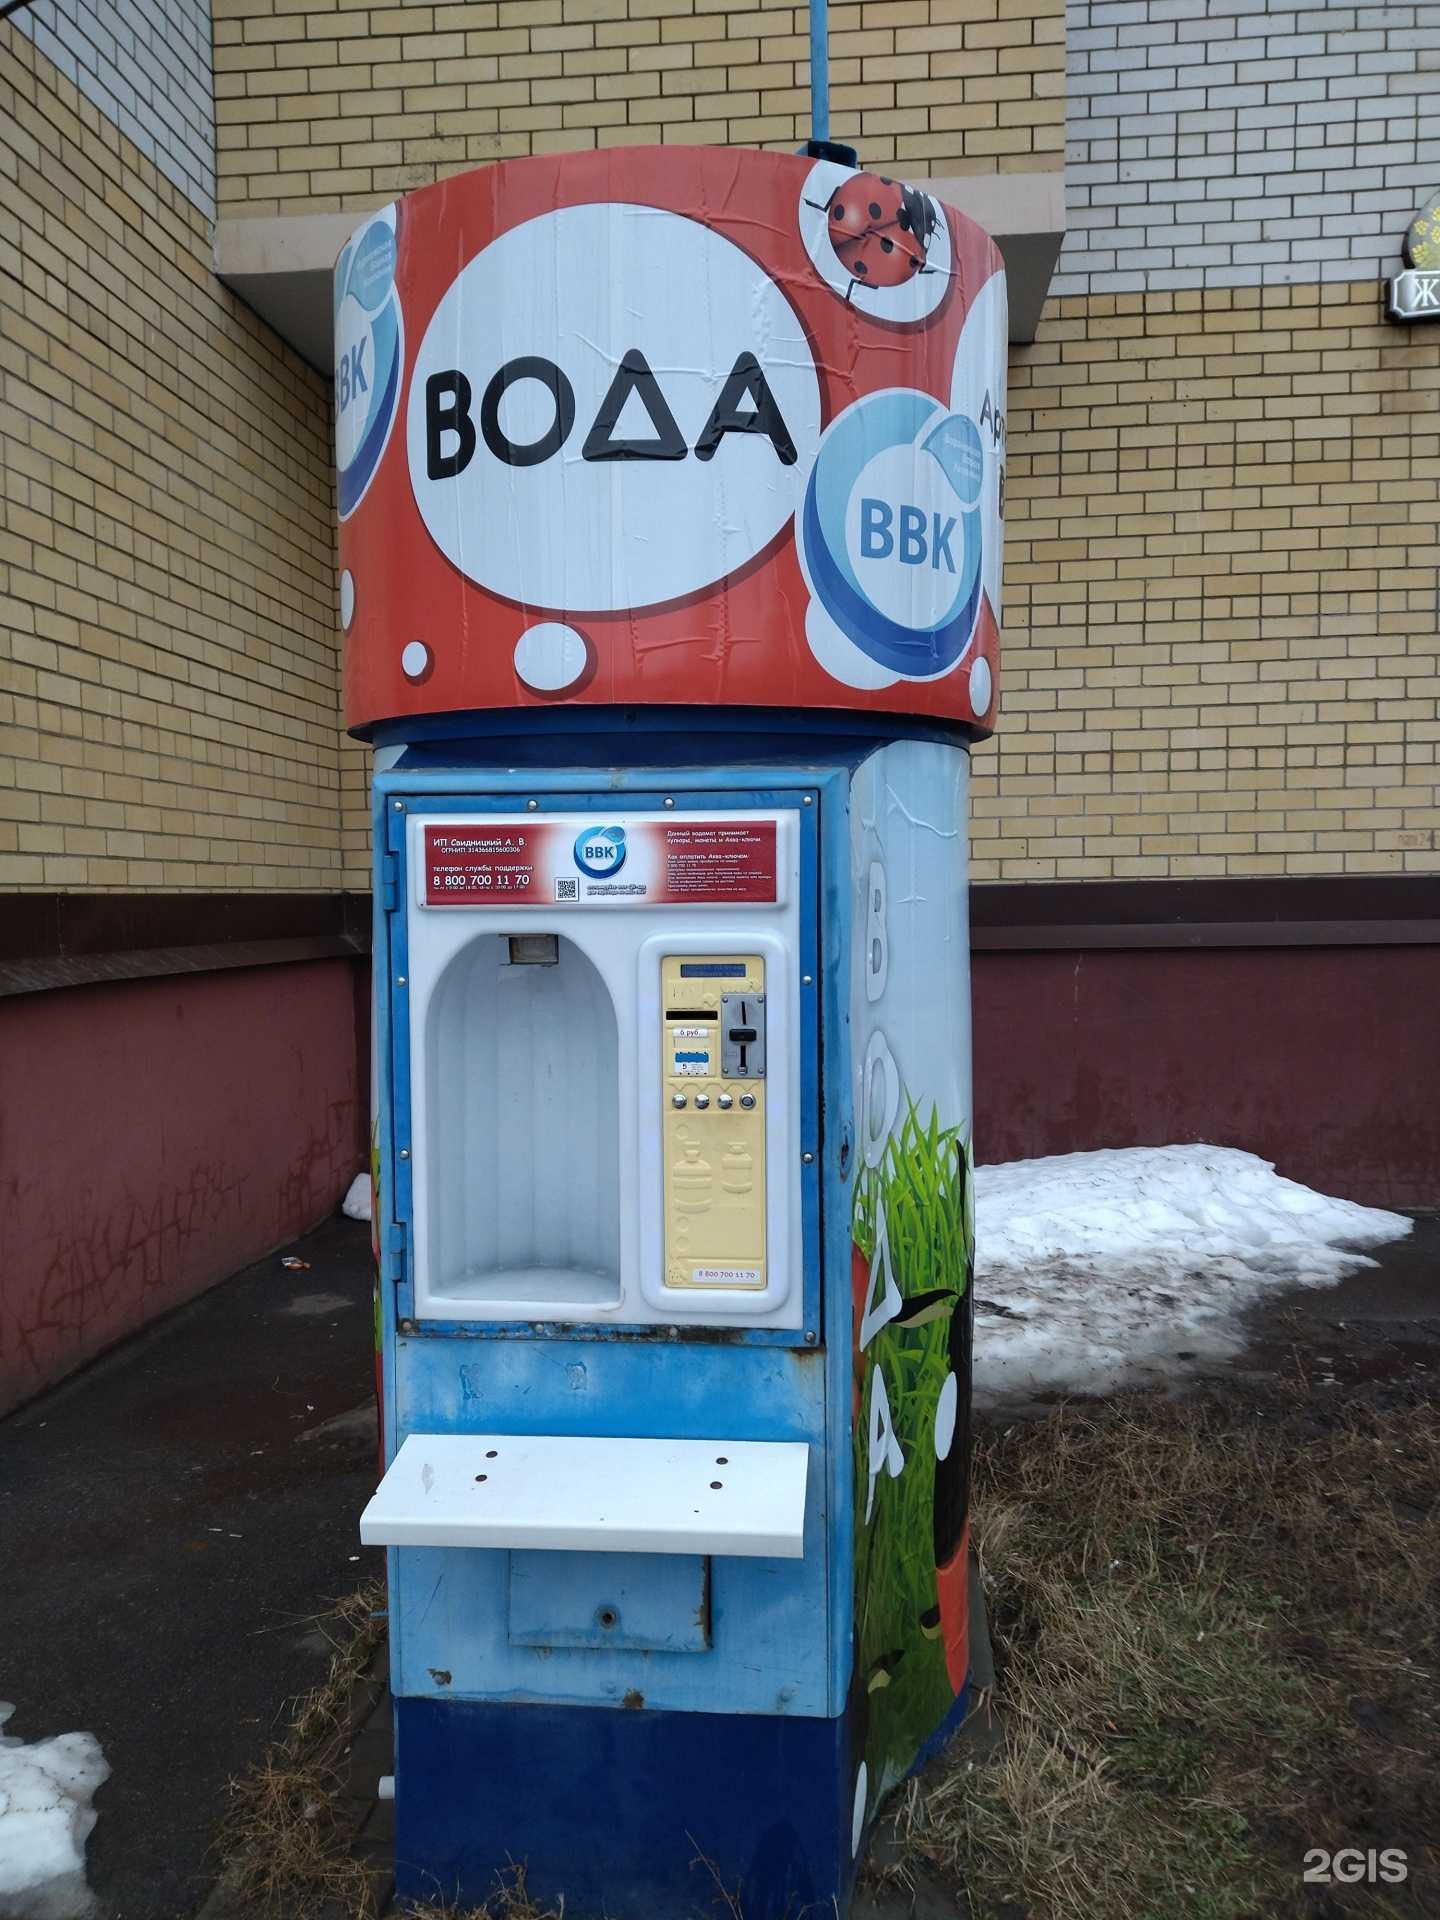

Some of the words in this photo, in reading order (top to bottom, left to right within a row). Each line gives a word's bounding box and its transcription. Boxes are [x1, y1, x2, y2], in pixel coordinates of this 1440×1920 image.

[335, 336, 368, 423] ВК
[426, 348, 798, 481] ВОДА
[860, 498, 957, 574] ВВК
[433, 838, 448, 847] ИП
[450, 838, 502, 848] Свидницкий
[585, 846, 614, 859] ВВК
[432, 866, 463, 874] телефон
[465, 864, 492, 874] службы
[495, 864, 533, 873] поддержки
[433, 876, 440, 886] 8
[445, 876, 466, 886] 800
[470, 875, 492, 886] 700
[497, 875, 509, 885] 11
[515, 874, 530, 885] 70
